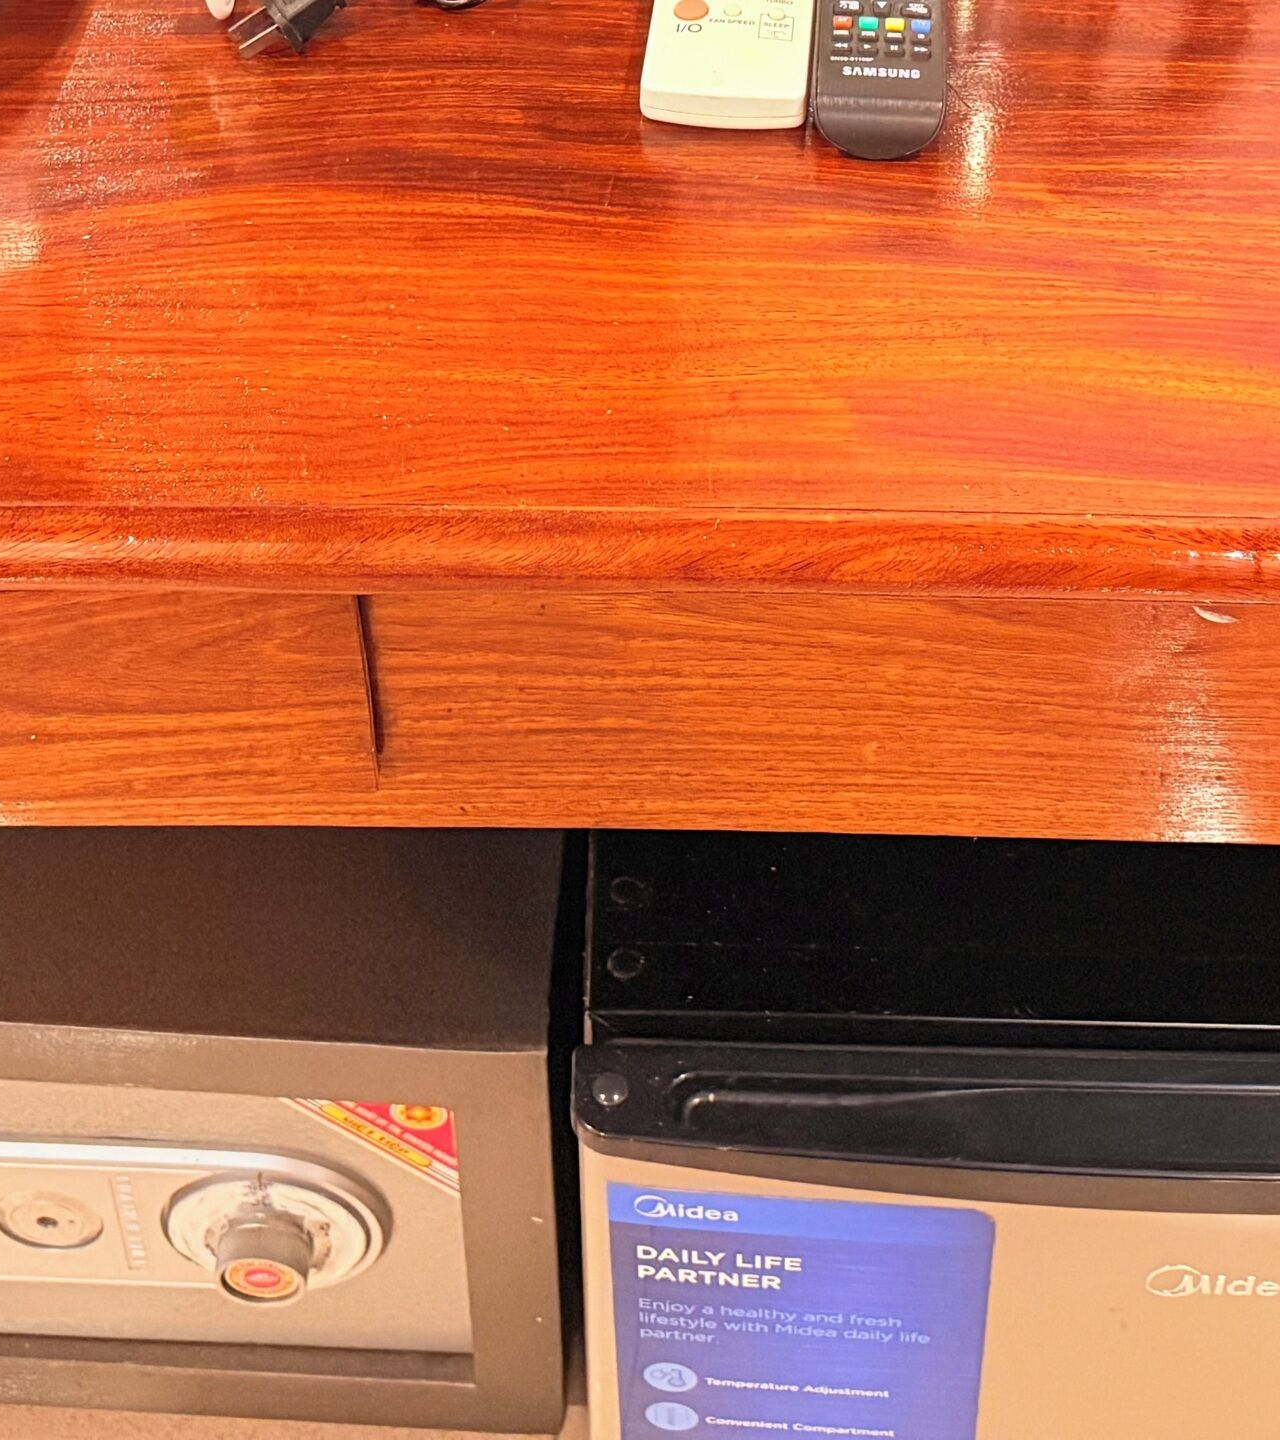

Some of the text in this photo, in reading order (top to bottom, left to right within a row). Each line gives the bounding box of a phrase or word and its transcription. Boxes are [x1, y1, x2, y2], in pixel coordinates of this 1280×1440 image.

[842, 65, 921, 79] SAMSUNG
[634, 1195, 739, 1222] Midea
[636, 1244, 803, 1272] DAILY LIFE
[637, 1264, 782, 1290] PARTNER
[638, 1297, 902, 1328] Enjoy a healthy and fresh
[639, 1311, 931, 1345] lifestyle with Midea daily life
[705, 1376, 889, 1399] Temperature Adjustment
[705, 1415, 895, 1438] Convenient Compartment
